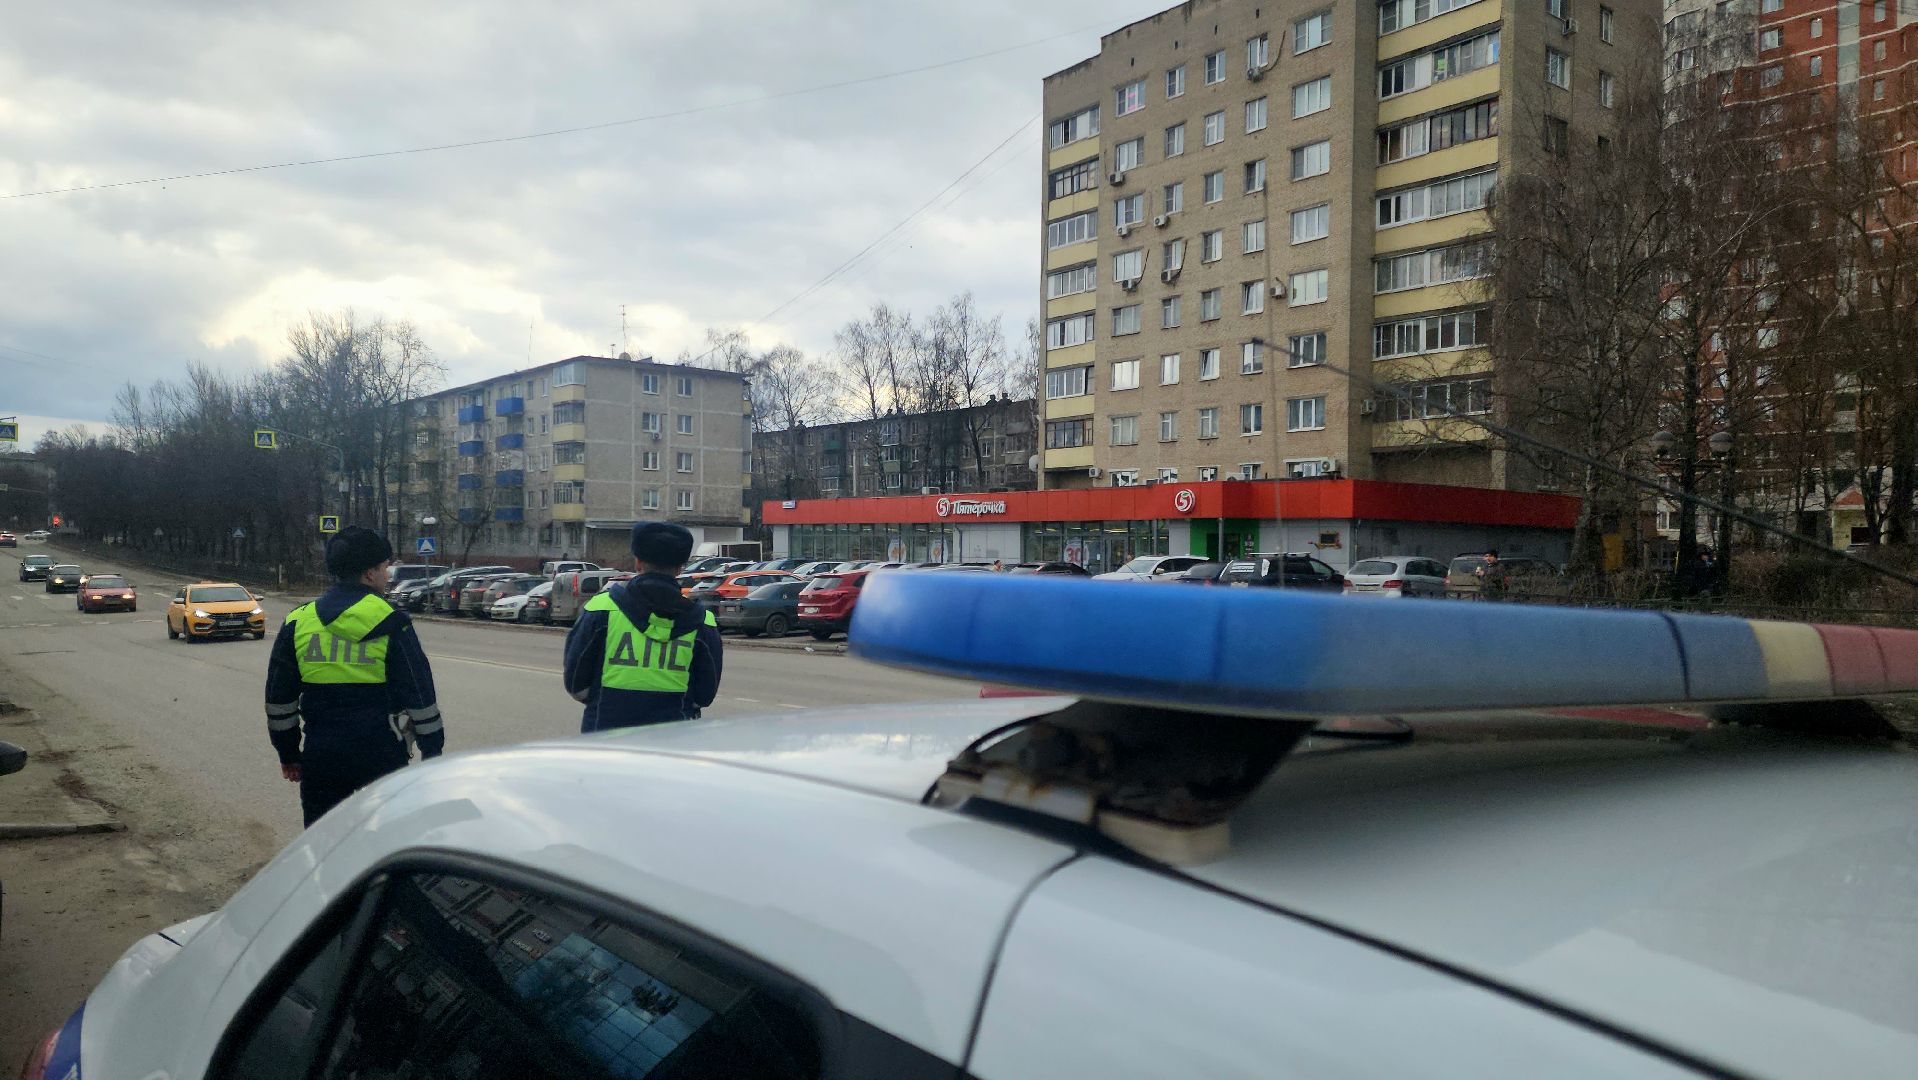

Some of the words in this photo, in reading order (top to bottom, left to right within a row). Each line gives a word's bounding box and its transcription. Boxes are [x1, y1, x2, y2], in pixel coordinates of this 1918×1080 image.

[951, 500, 1006, 517] Пятерочка
[304, 633, 378, 664] ДПС
[609, 632, 692, 671] ДПС
